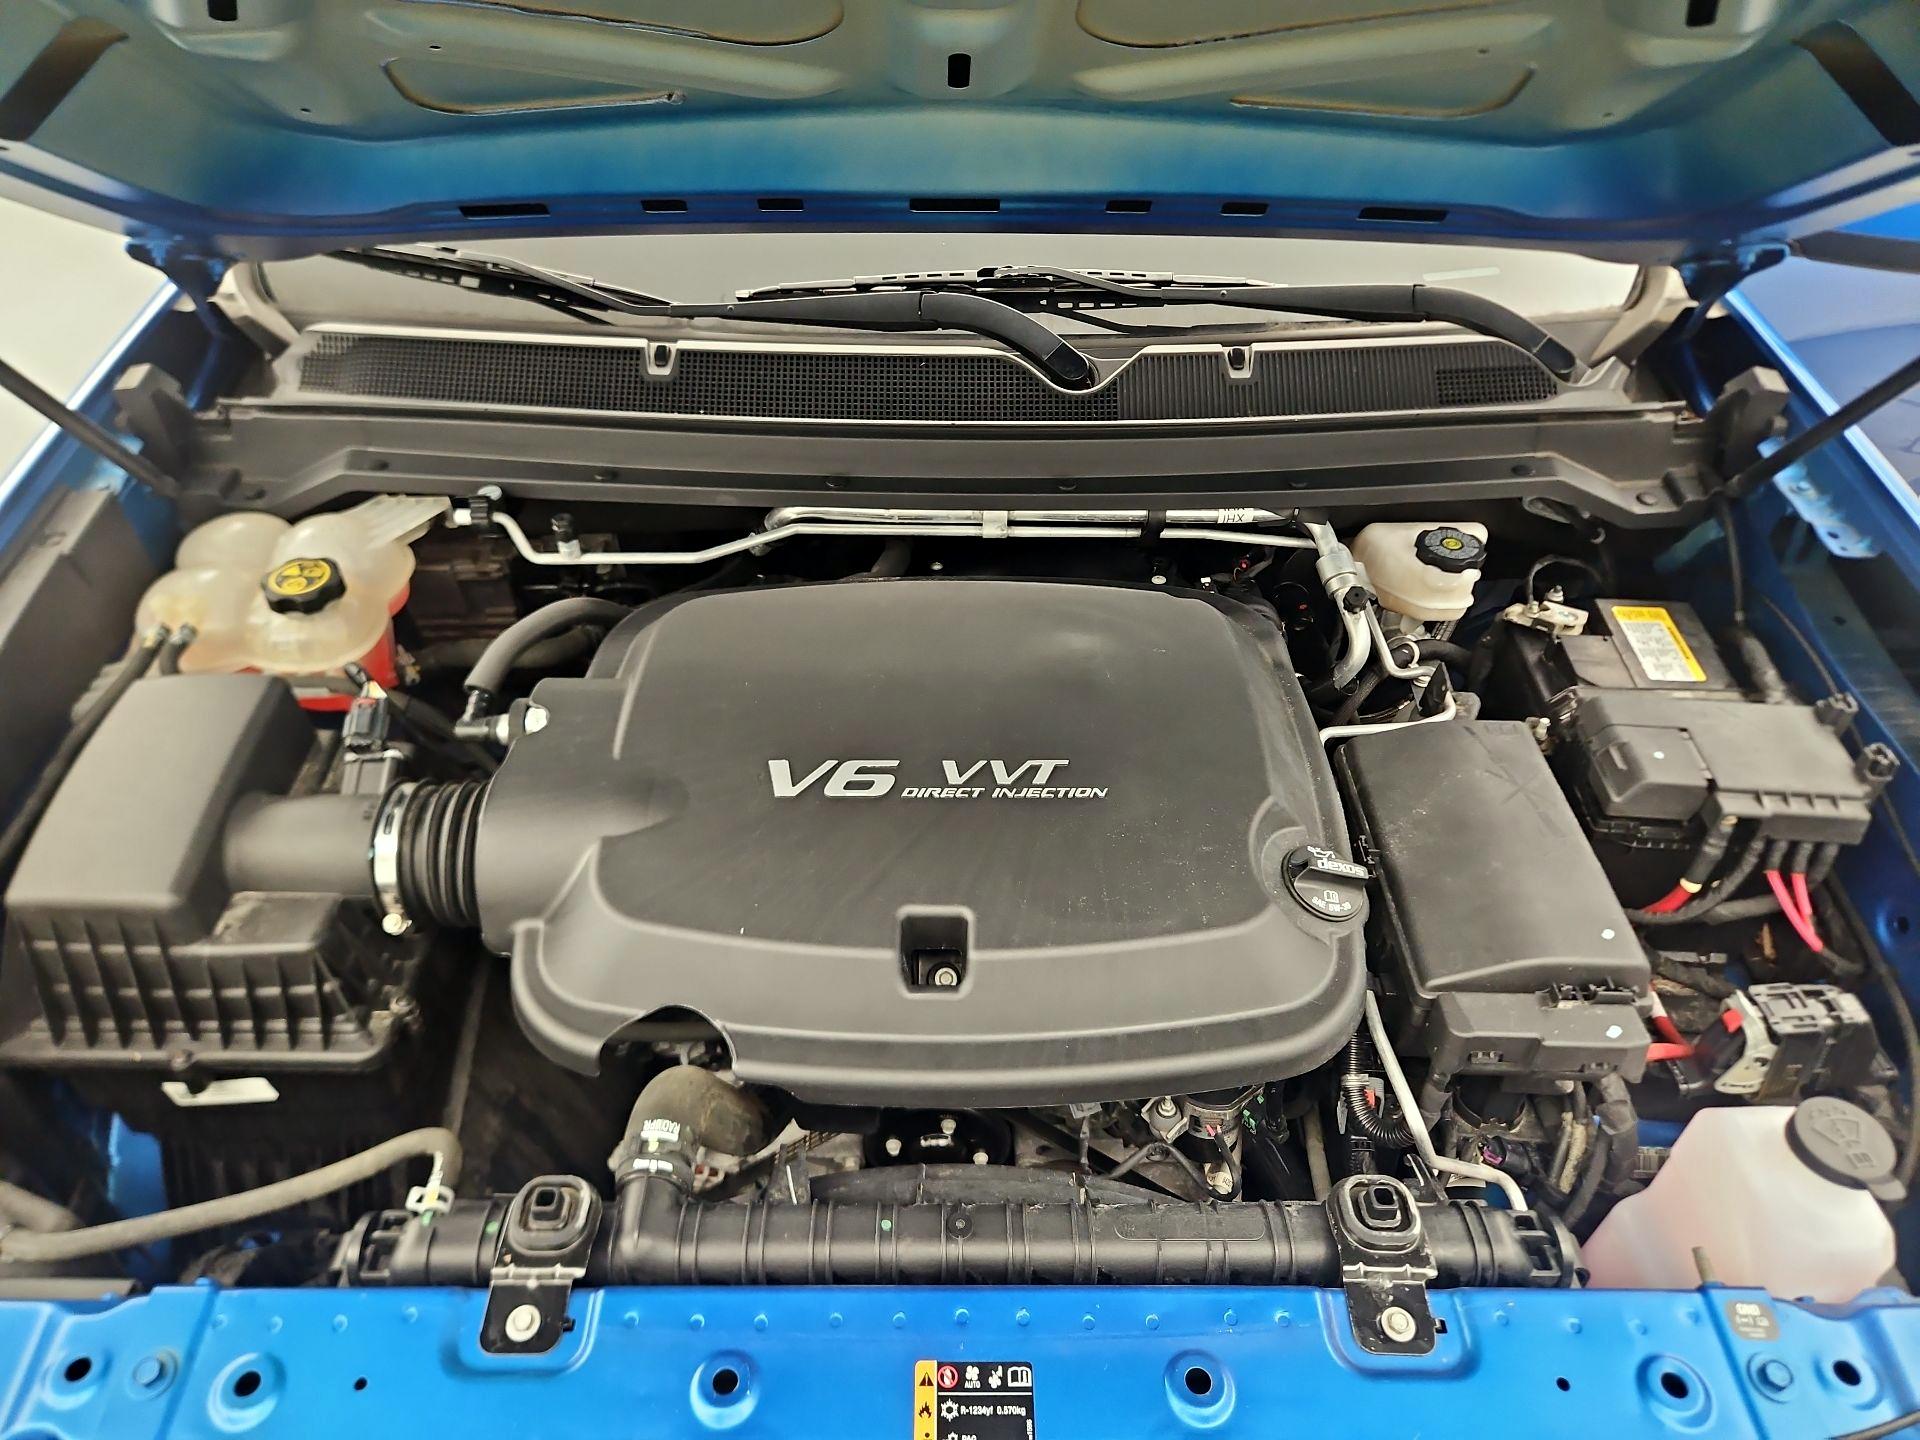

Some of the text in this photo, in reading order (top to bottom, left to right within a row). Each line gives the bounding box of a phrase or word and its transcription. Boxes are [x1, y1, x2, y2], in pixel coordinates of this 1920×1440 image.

[768, 760, 900, 797] V6
[942, 760, 1070, 785] VVT
[901, 787, 1109, 798] DIRECT INJECTION
[1317, 857, 1365, 877] dexos
[1312, 896, 1327, 909] SAE
[964, 1380, 981, 1389] AUTO
[960, 1405, 1027, 1417] R-1234yf 0.570kg
